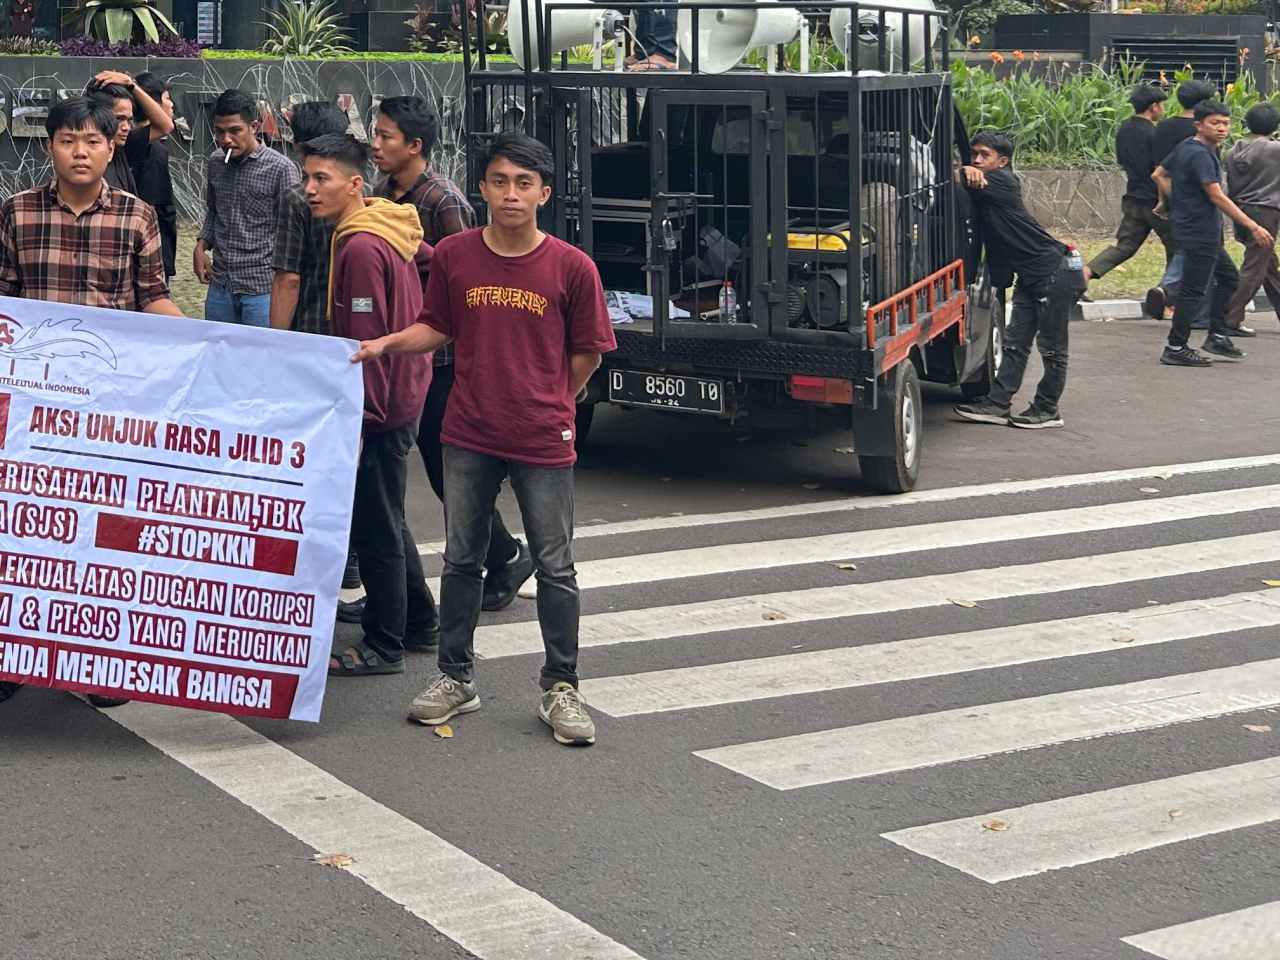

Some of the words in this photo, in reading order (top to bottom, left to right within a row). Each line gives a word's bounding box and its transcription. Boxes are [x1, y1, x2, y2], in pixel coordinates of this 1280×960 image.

[45, 382, 91, 396] INDONESIA
[613, 371, 623, 390] D
[645, 375, 685, 397] 8560
[30, 405, 80, 438] AKSI
[86, 413, 159, 449] UNJUK
[165, 422, 221, 458] RASA
[228, 432, 284, 467] JILID
[290, 441, 306, 470] 3
[13, 506, 77, 541] (SJS)
[138, 524, 256, 567] #STOPKKN
[84, 567, 133, 599] ATAS
[142, 578, 224, 612] DUGAAN
[233, 588, 315, 626] KORUPSI
[21, 598, 39, 628] &
[130, 615, 185, 648] YANG
[196, 623, 309, 666] MERUGIKAN
[56, 651, 181, 699] MENDESAK
[187, 669, 273, 710] BANGSA
